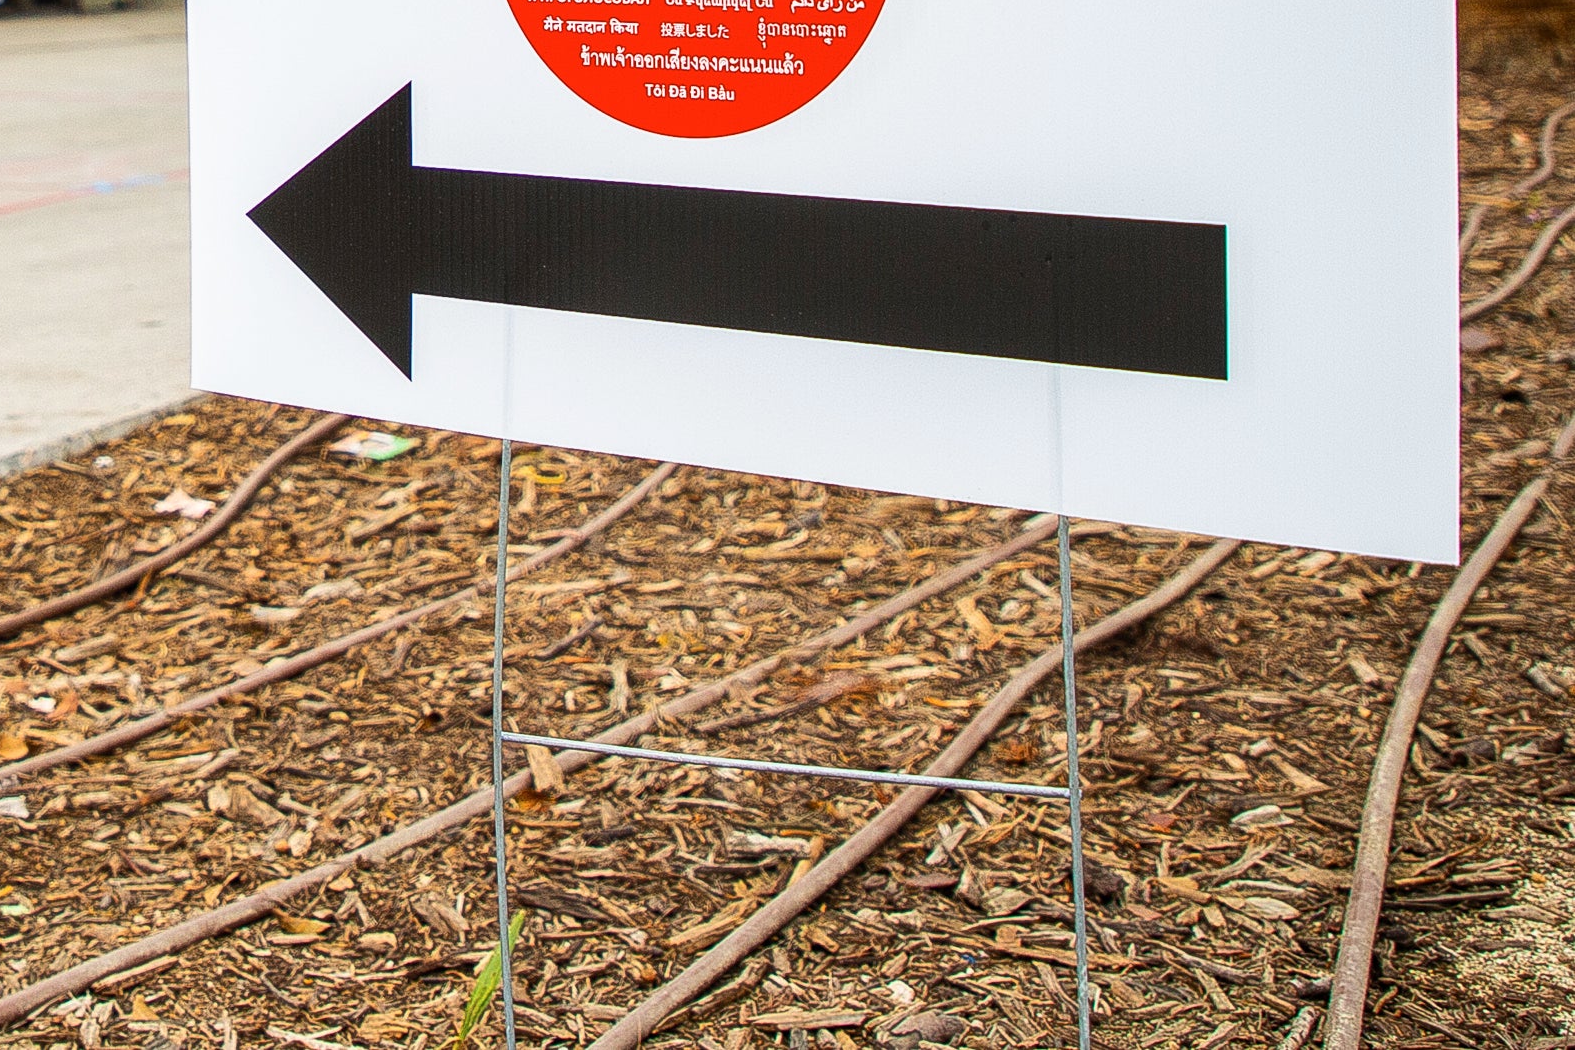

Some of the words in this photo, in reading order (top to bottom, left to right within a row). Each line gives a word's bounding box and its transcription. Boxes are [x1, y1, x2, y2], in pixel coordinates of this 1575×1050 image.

[566, 20, 607, 34] मतदान
[609, 17, 639, 35] किया
[660, 22, 730, 39] 投票しました
[580, 44, 804, 75] ข้าพเจ้าออกเสียงลงคะแนนแล้ว
[644, 83, 666, 98] Tôi
[668, 85, 687, 99] Đã
[689, 85, 705, 99] Đi
